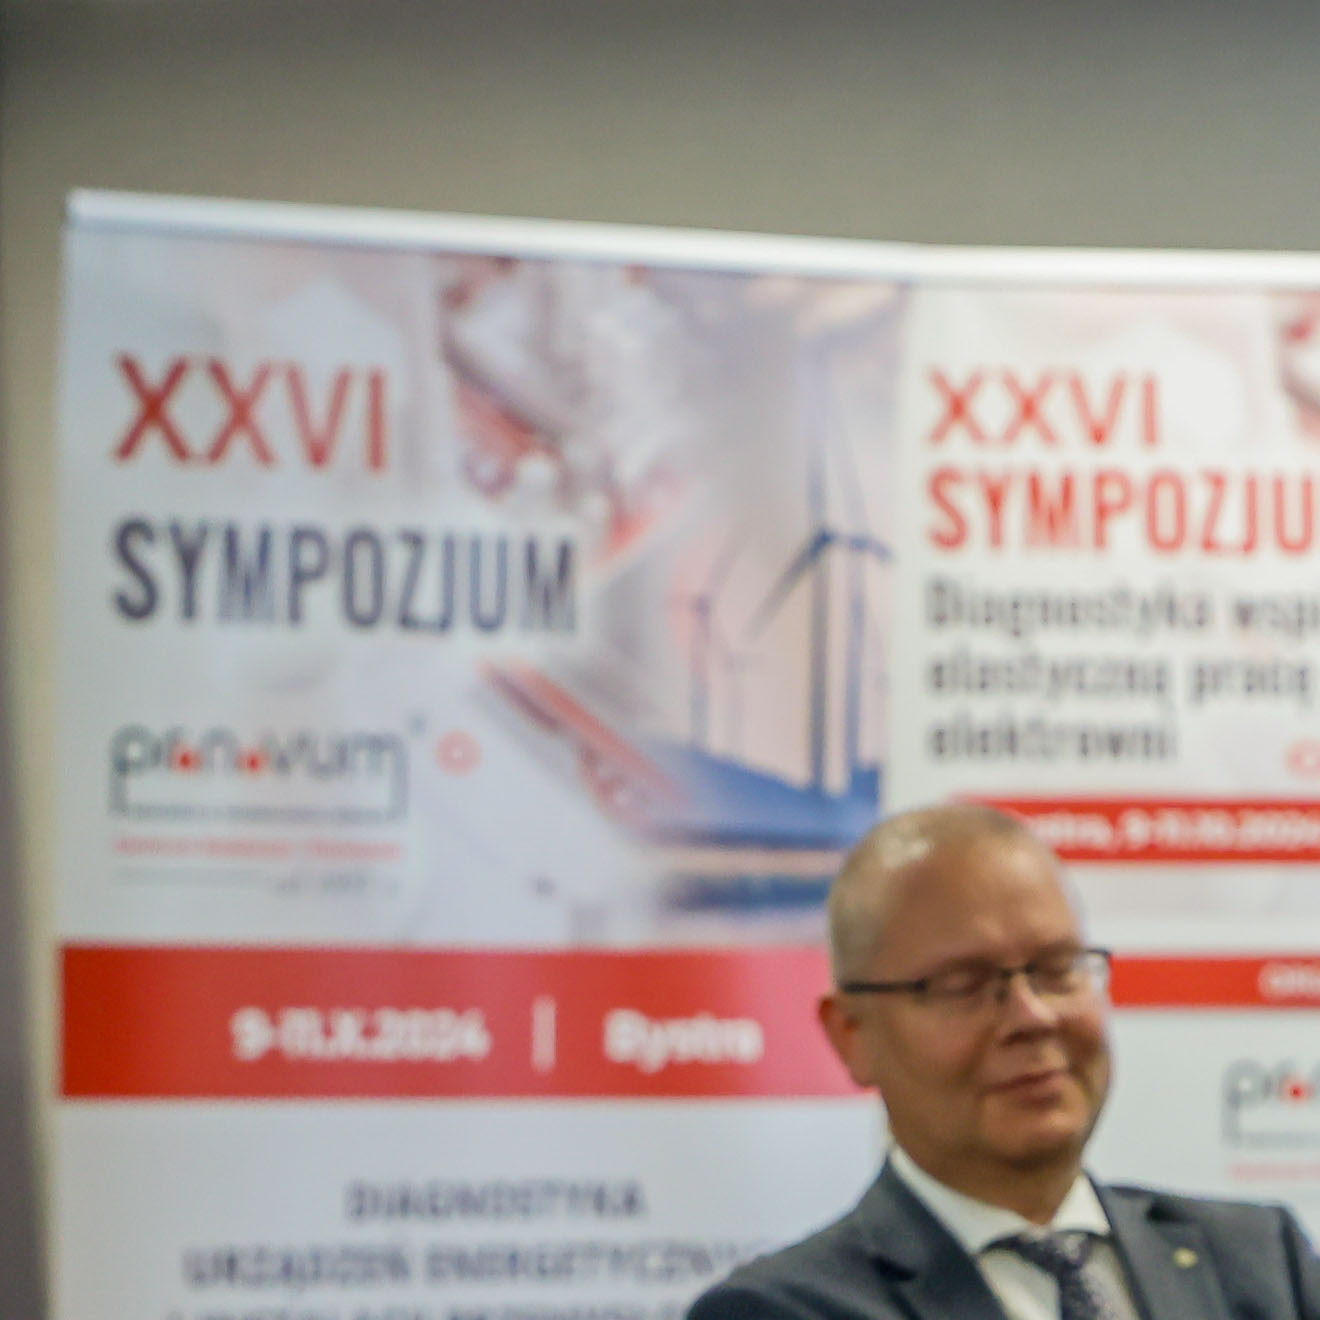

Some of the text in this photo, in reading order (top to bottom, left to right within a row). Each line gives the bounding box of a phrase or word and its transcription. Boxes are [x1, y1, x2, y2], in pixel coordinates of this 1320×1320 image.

[112, 352, 390, 470] XXVI
[929, 371, 1158, 447] XXVI
[113, 518, 580, 632] SYMPOZJUM
[925, 576, 1212, 638] Diagnostyka
[1190, 655, 1312, 706] pracę
[928, 708, 1174, 760] elektrowni
[345, 1179, 642, 1221] DIAGNOSTYKA
